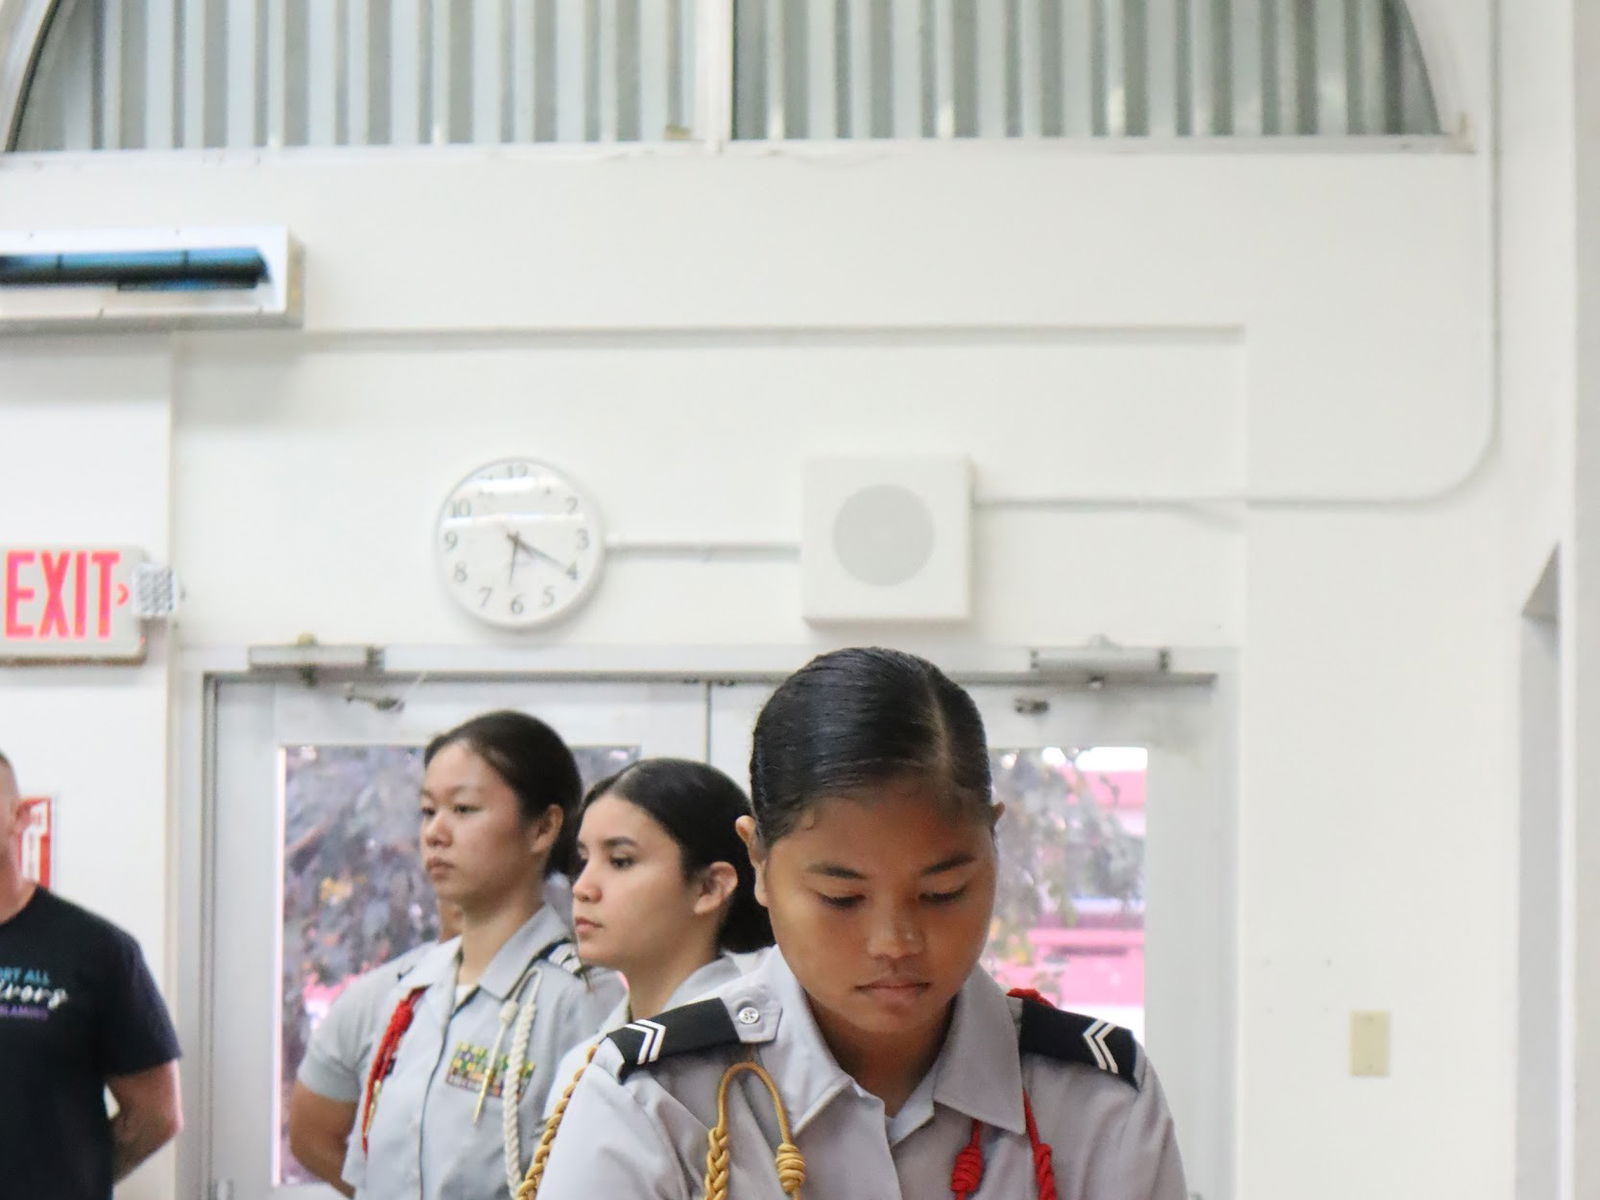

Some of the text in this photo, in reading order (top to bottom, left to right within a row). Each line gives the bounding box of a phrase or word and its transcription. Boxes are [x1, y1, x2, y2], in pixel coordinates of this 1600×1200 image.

[444, 531, 459, 551] 9
[576, 528, 590, 551] 3
[454, 562, 468, 583] 8
[5, 551, 121, 638] EXIT
[479, 586, 493, 608] 7
[510, 594, 524, 616] 6
[541, 585, 555, 608] 5
